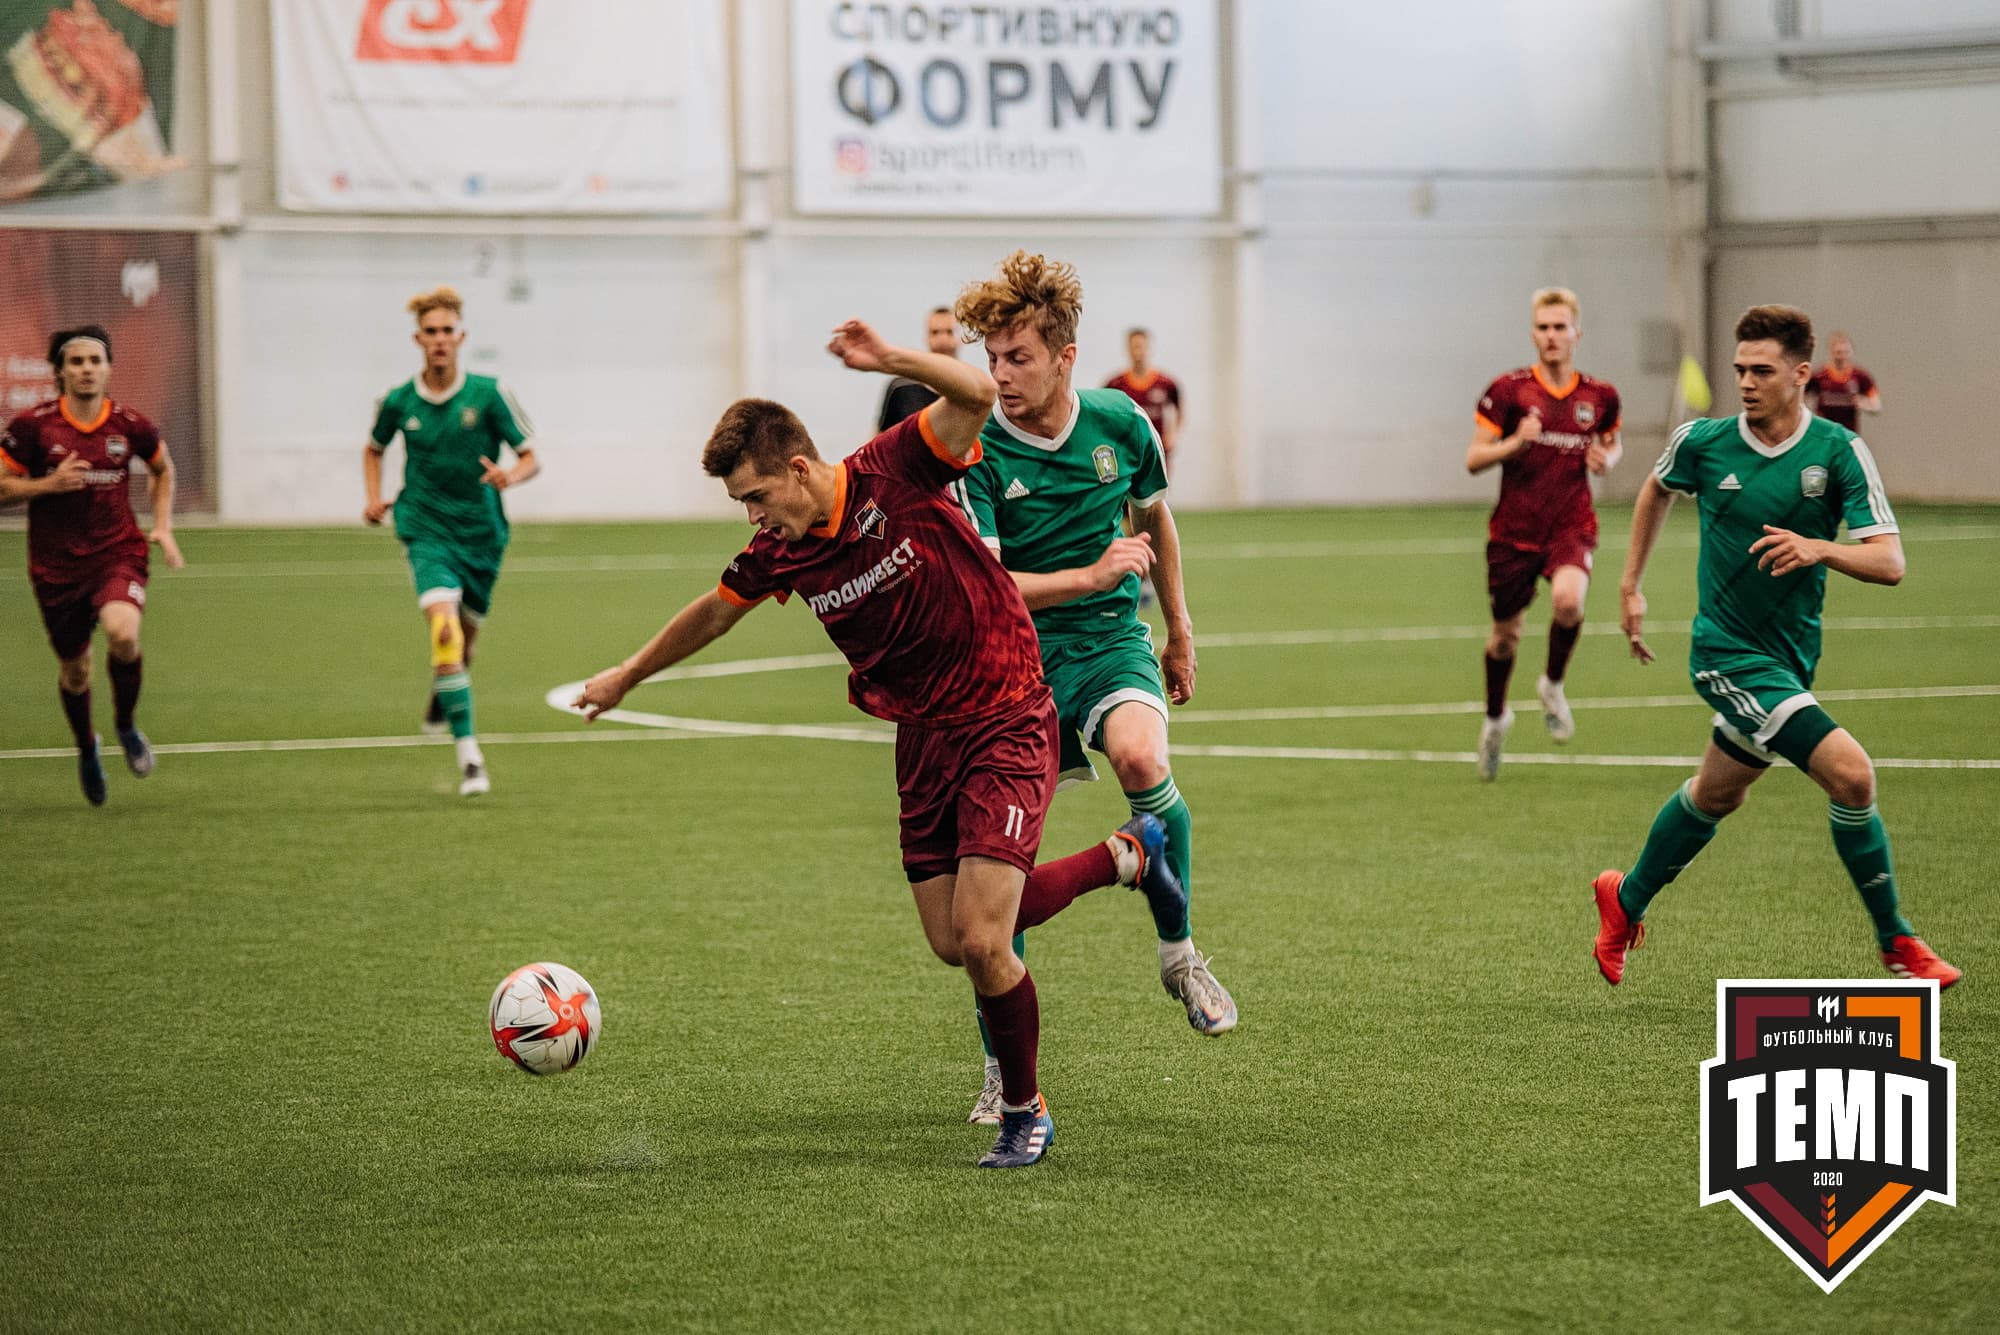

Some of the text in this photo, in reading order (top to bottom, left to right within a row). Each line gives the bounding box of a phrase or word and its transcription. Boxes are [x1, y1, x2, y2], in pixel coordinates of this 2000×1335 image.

[831, 4, 1181, 45] СПОРТИВНУЮ
[837, 56, 1177, 129] ФОРМУ
[808, 537, 915, 614] ПРОДИНВЕСТ
[1004, 804, 1024, 841] 11
